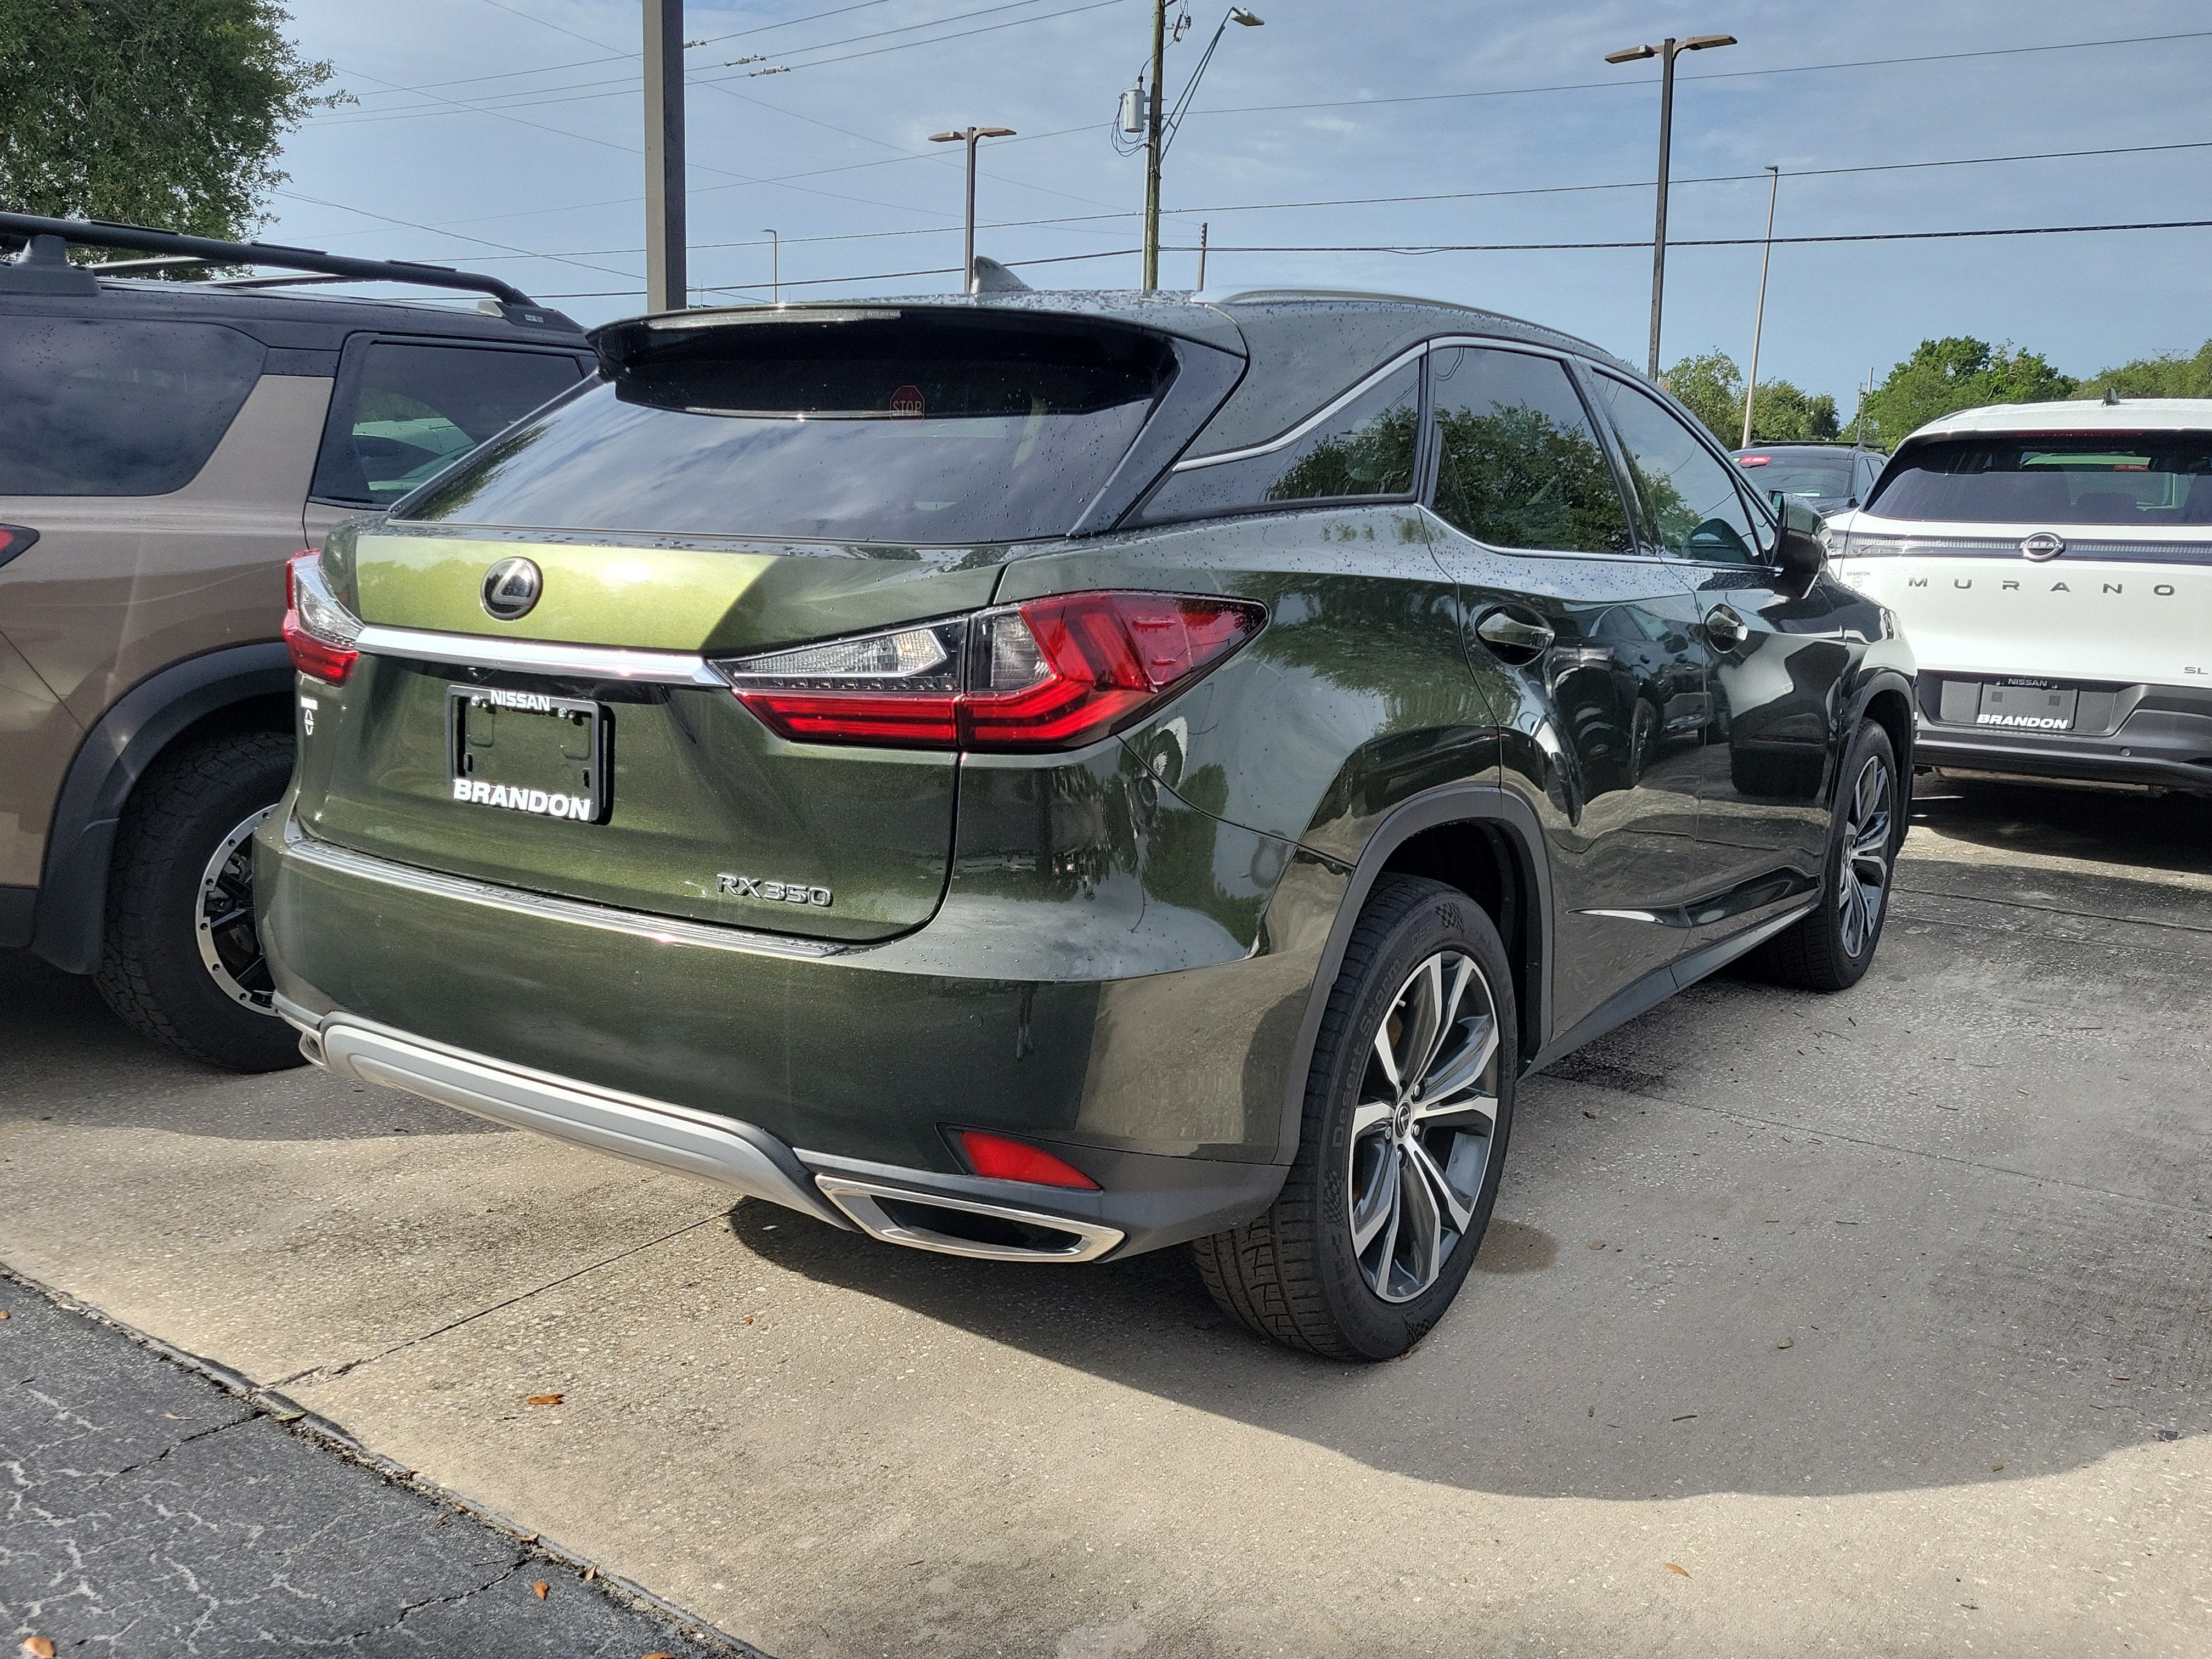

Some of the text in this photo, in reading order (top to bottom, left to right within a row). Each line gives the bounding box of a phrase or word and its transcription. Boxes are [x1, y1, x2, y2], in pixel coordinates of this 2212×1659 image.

[893, 400, 922, 416] STOP
[1908, 577, 2175, 596] MURANO
[2184, 667, 2209, 675] SL
[2007, 678, 2048, 686] NISSAN
[490, 690, 550, 711] NISSAN
[1976, 714, 2068, 729] BRANDON
[453, 778, 592, 821] BRANDON
[1332, 1043, 1363, 1147] Desert
[1359, 960, 1400, 1037] Storm
